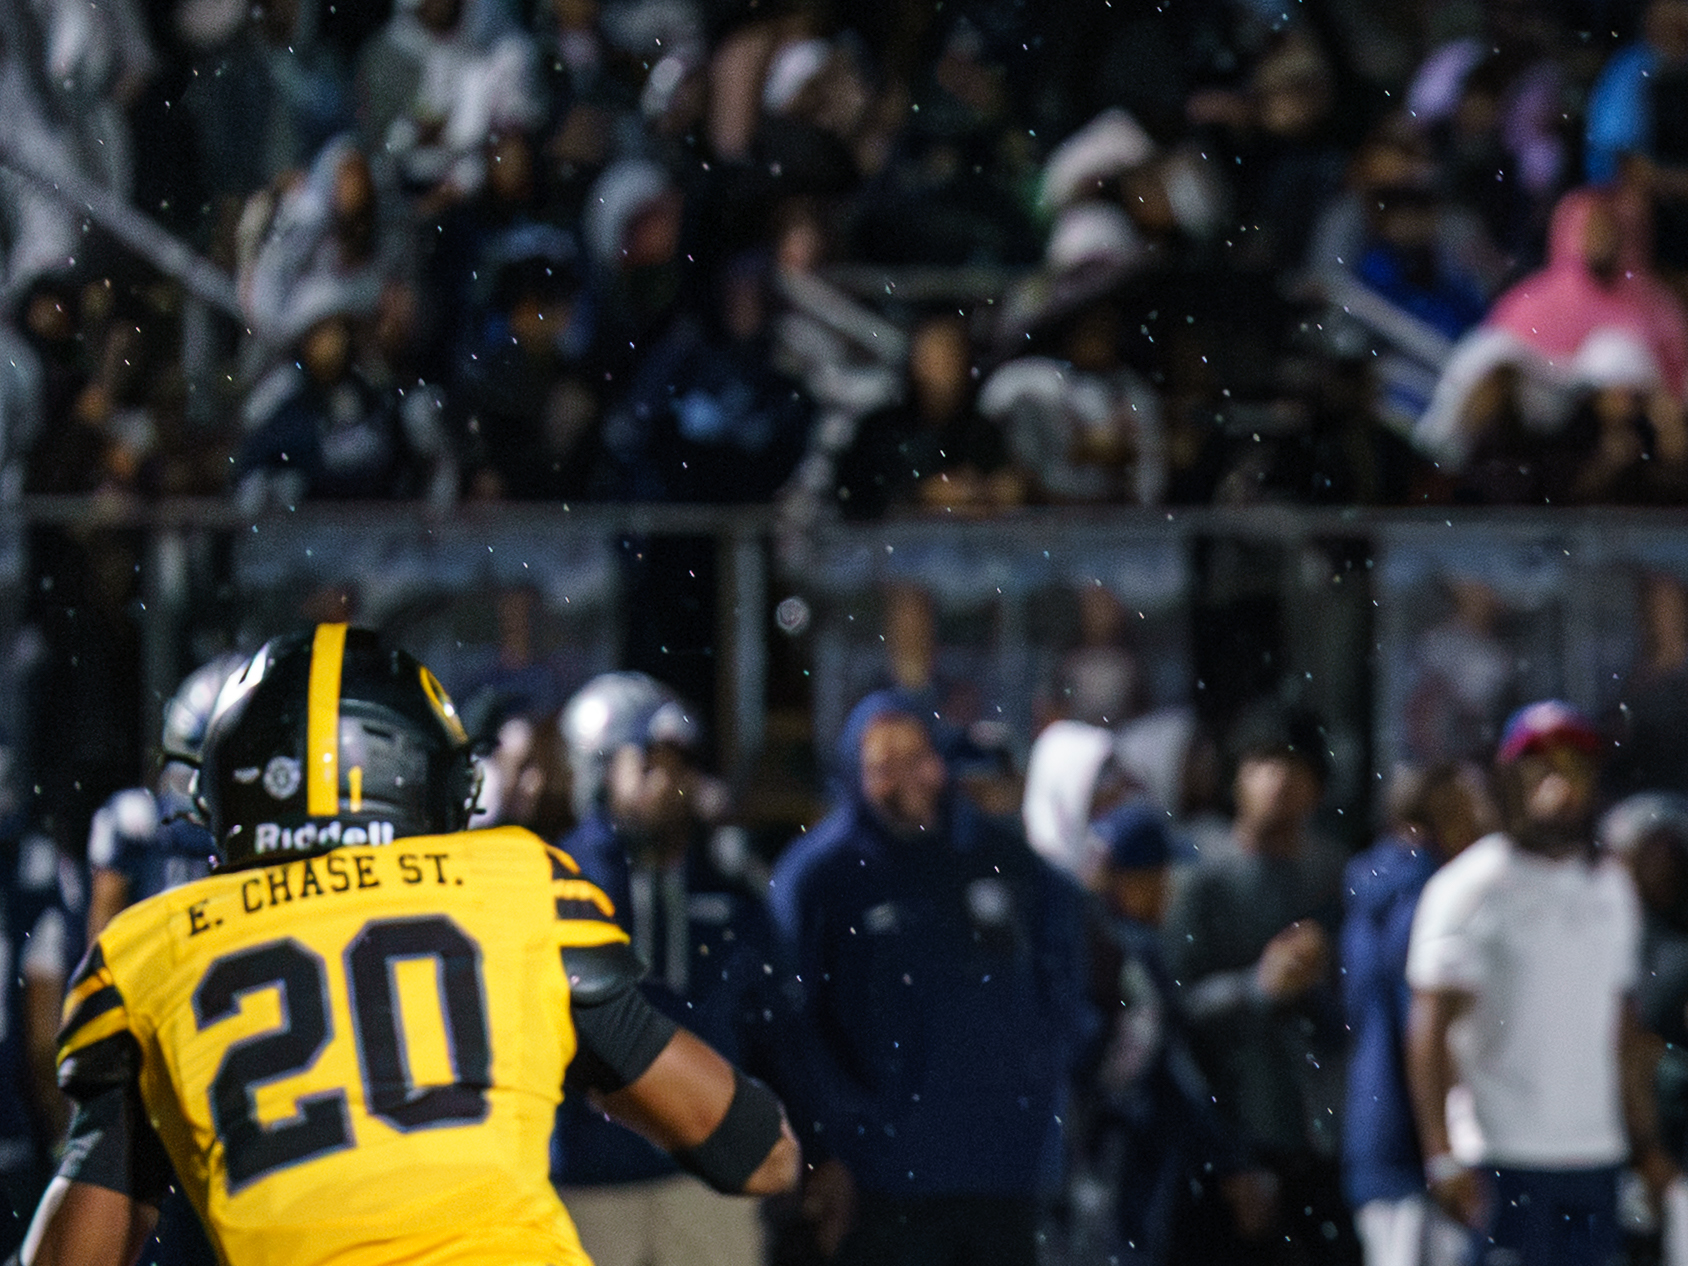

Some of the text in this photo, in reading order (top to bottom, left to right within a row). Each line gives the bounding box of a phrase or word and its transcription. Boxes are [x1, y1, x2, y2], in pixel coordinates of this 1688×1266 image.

[254, 820, 395, 854] Riddell
[188, 853, 464, 936] E. CHASE ST.
[191, 913, 494, 1198] 20
